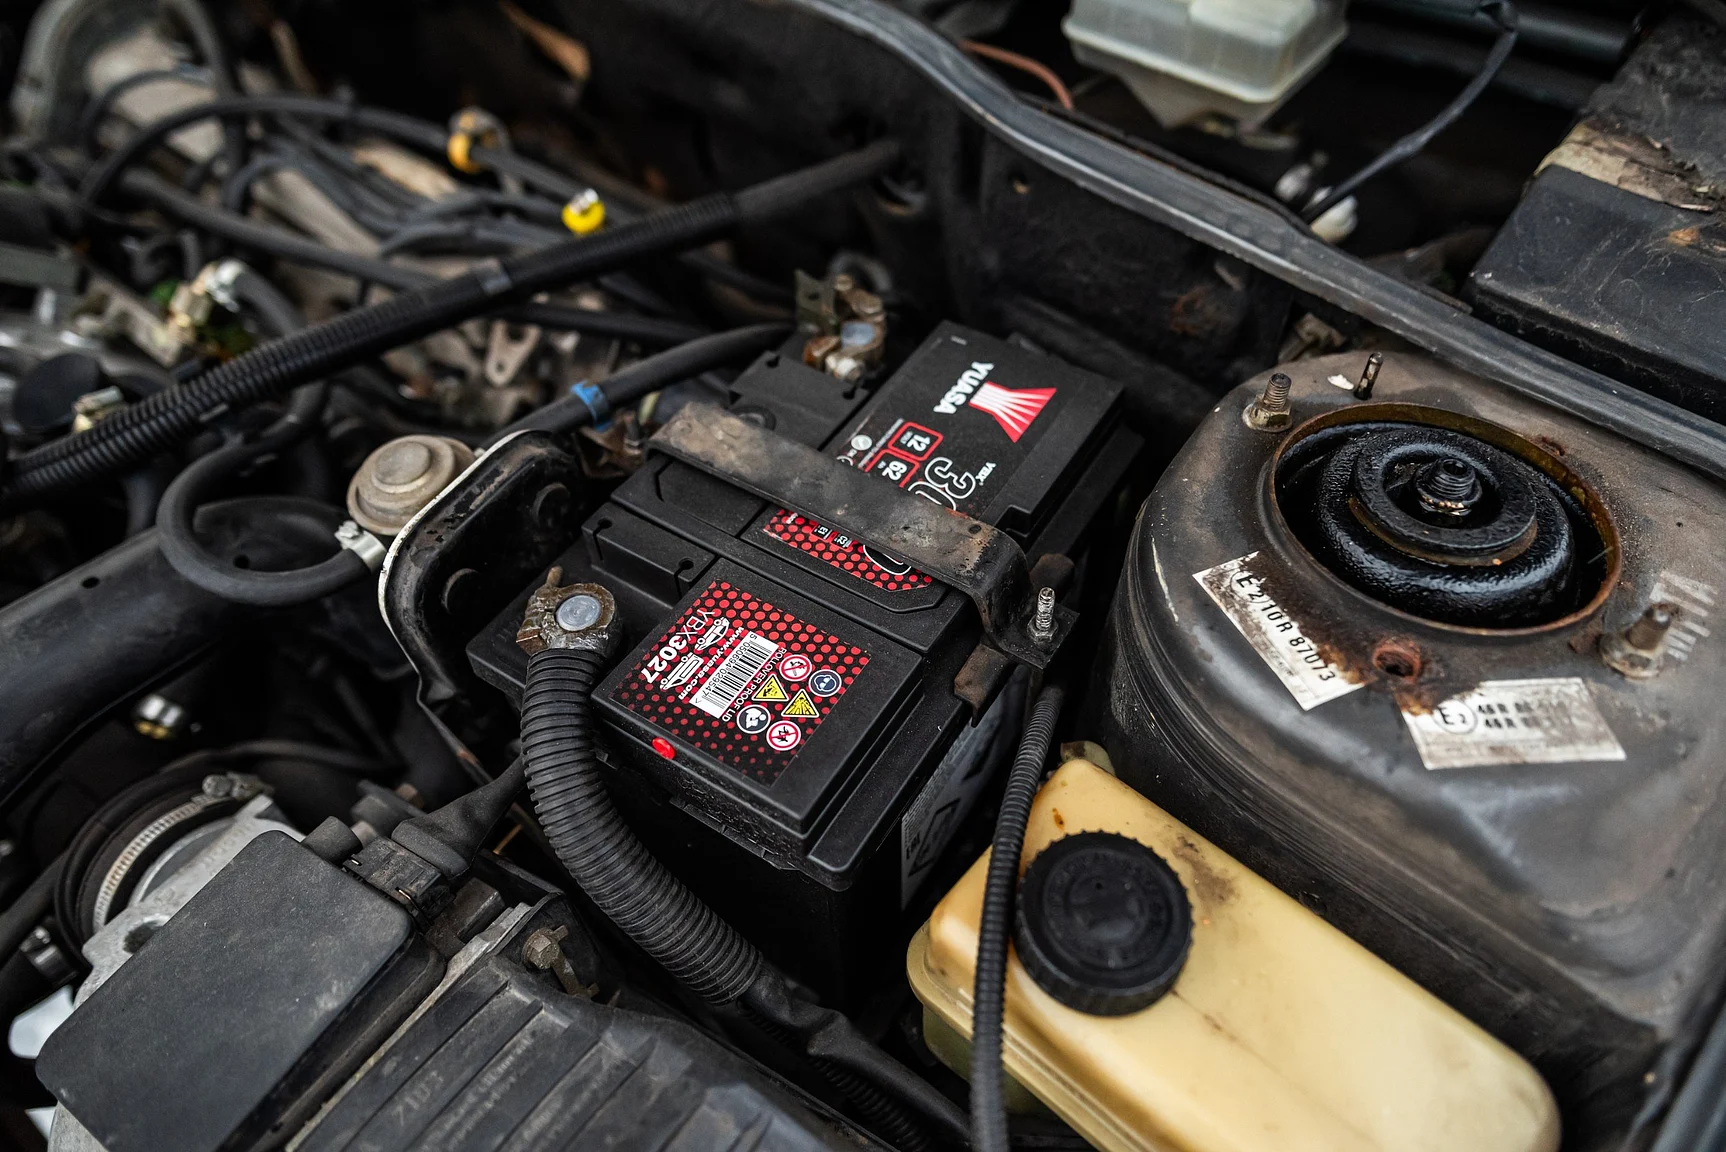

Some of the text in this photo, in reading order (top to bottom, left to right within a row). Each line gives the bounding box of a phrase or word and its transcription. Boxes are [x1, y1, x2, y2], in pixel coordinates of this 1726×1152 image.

[933, 362, 994, 414] YUASA
[907, 434, 930, 451] 12
[882, 460, 907, 480] 62
[975, 462, 997, 483] YBX
[641, 608, 715, 683] YBX3027
[677, 626, 745, 700] www.yuasa.com
[726, 641, 750, 668] 050694
[1289, 636, 1336, 681] 87073
[702, 668, 727, 696] 029547
[722, 647, 787, 722] ROLLOVER PROOF LID
